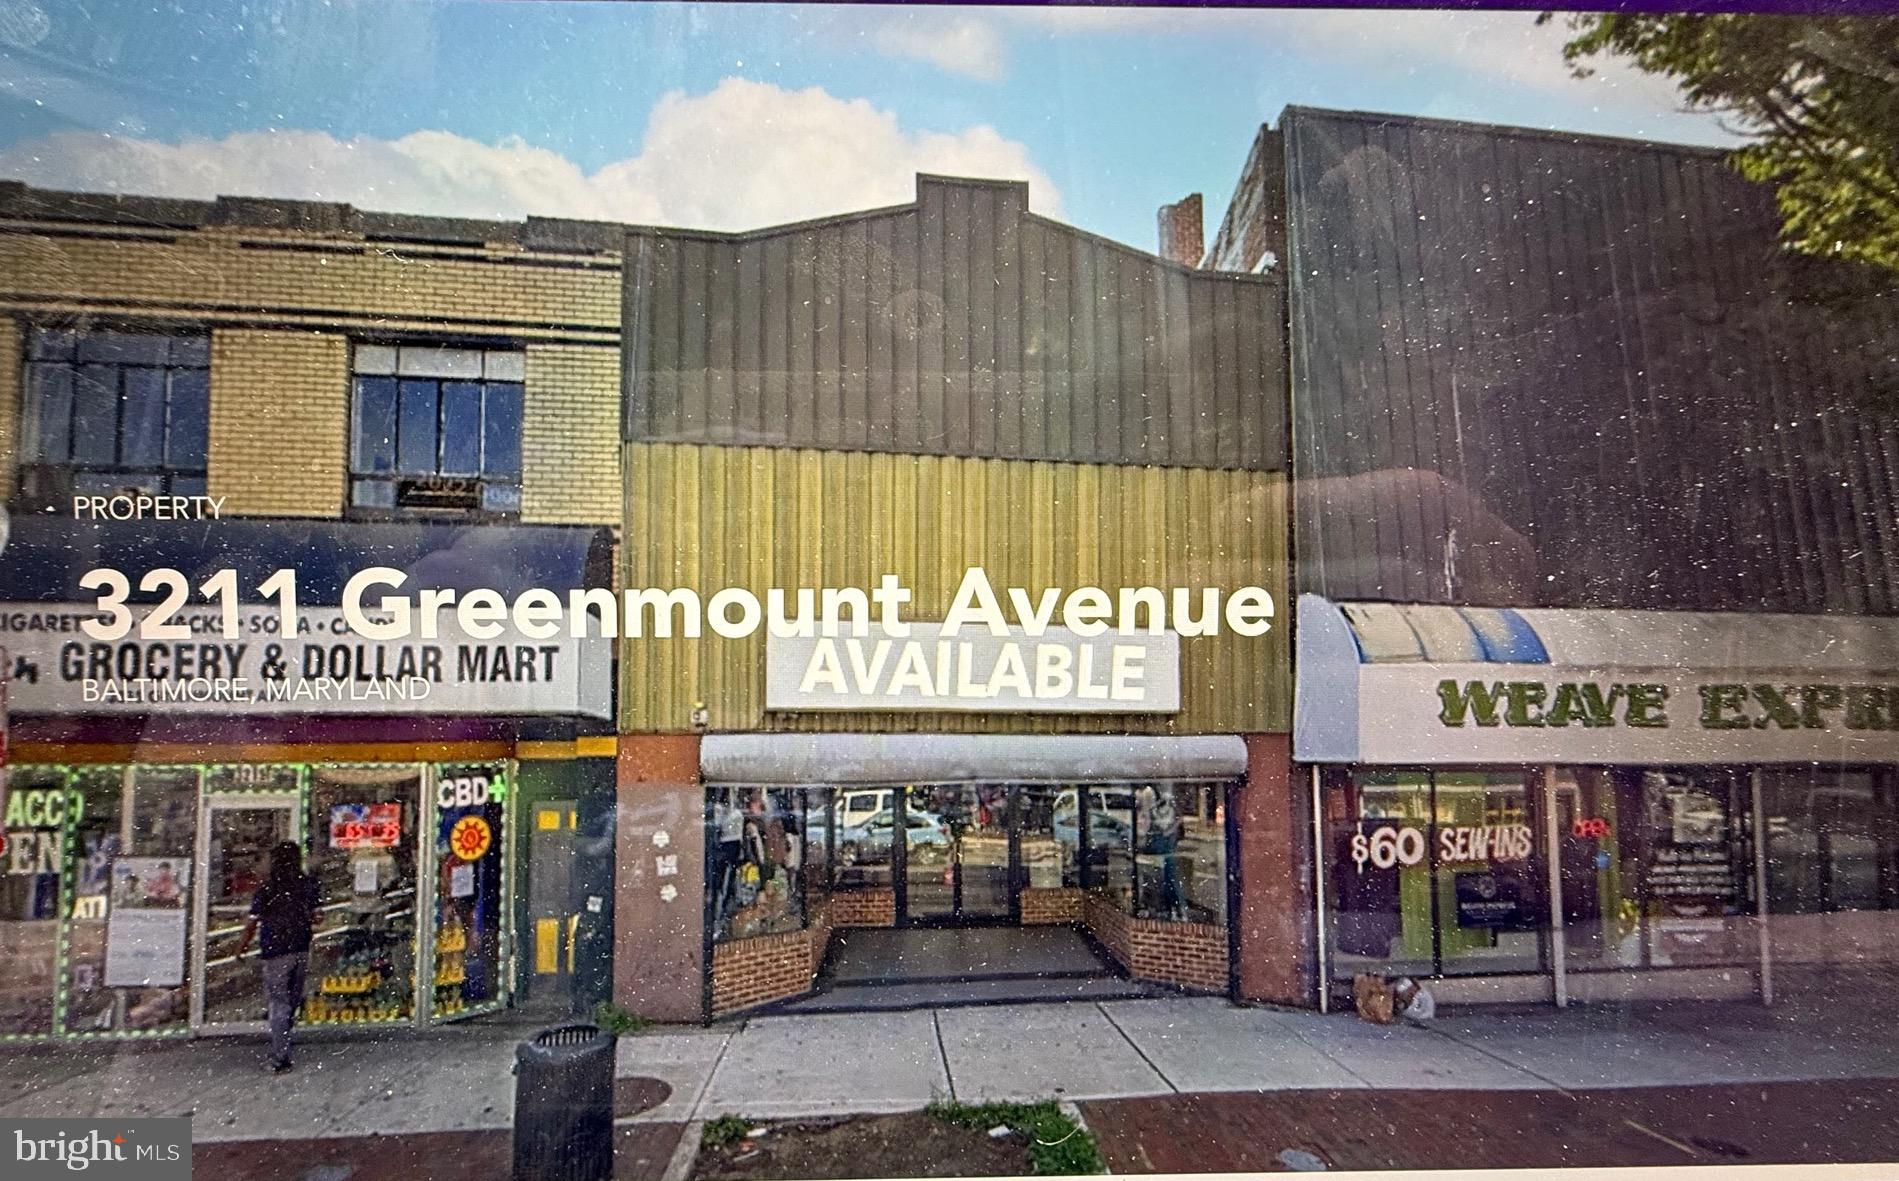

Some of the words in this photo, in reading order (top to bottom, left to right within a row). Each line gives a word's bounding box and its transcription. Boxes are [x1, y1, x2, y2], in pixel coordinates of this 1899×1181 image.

[60, 642, 248, 682] GROCERY
[260, 643, 288, 681] &
[303, 644, 443, 682] DOLLAR
[457, 645, 560, 683] MART
[799, 637, 1147, 702] AVAILABLE
[1436, 679, 1670, 728] WEAVE
[1698, 683, 1899, 731] EXPR
[1352, 822, 1425, 875] $60
